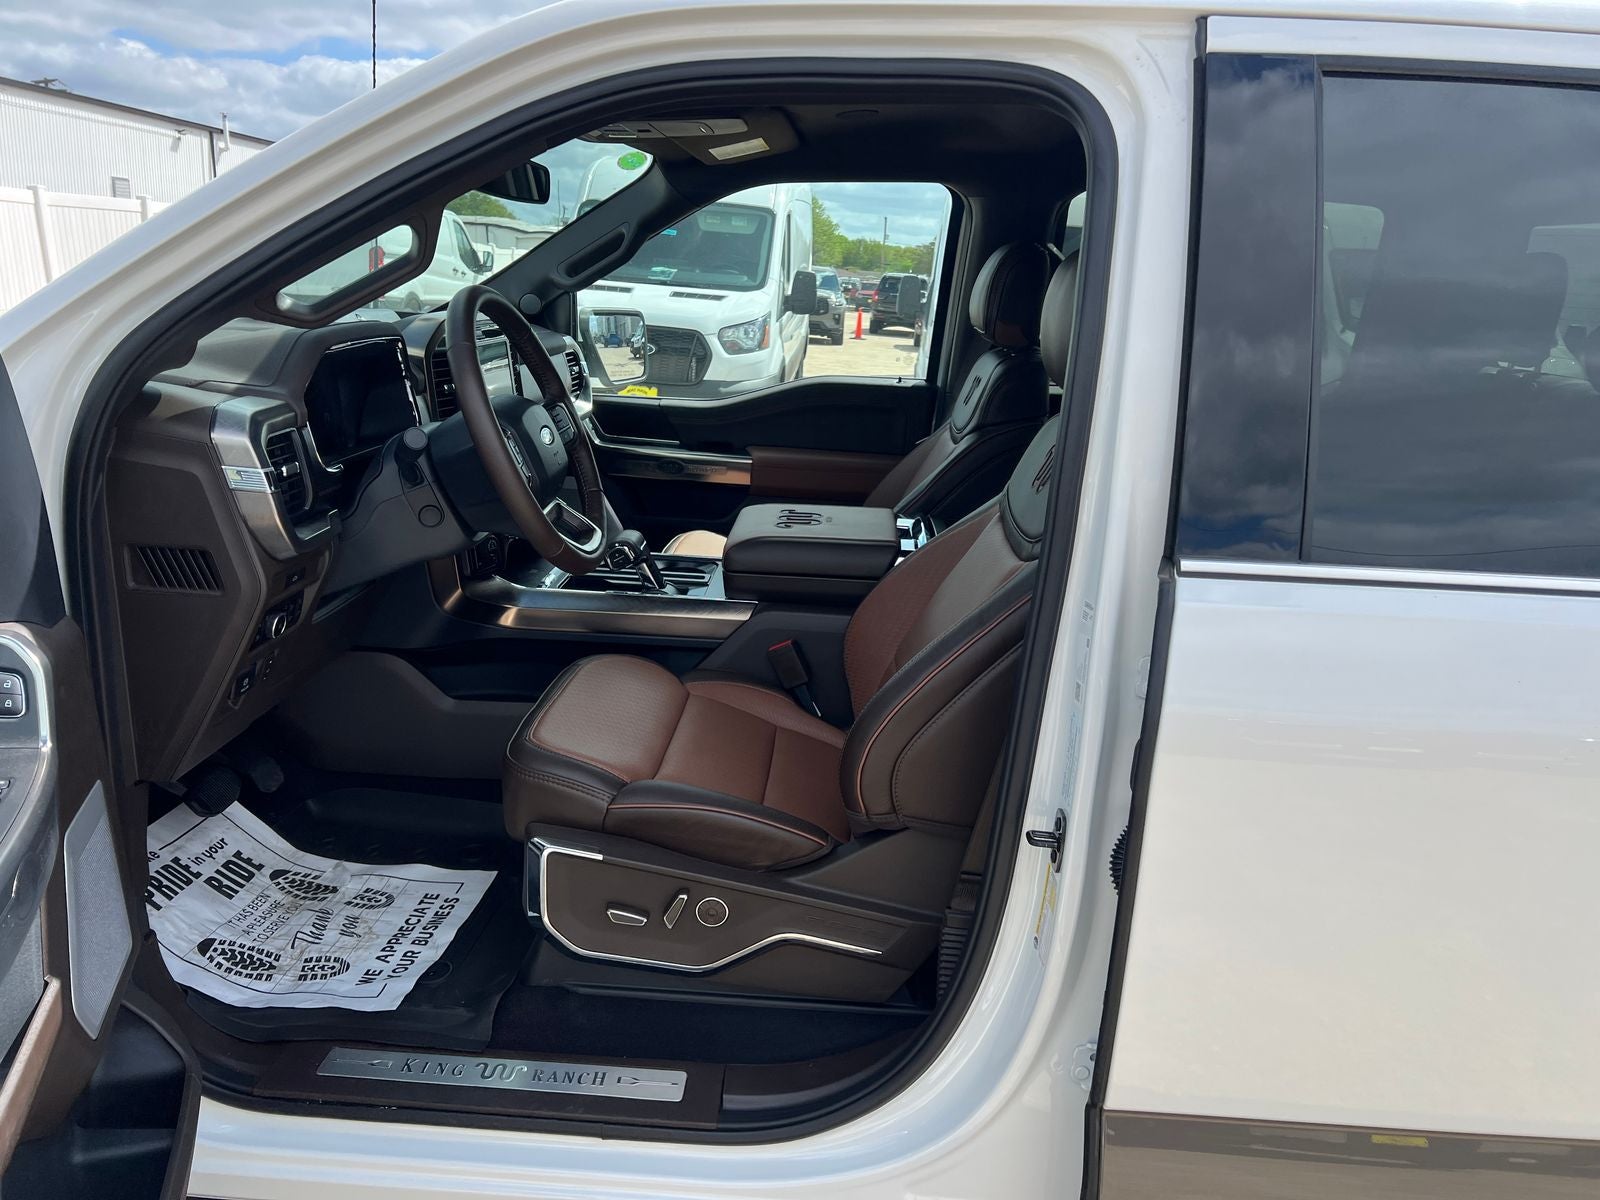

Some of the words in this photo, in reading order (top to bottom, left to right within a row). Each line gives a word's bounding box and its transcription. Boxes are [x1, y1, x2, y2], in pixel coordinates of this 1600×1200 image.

[145, 856, 203, 911] PRIDE
[187, 857, 206, 866] in
[201, 837, 229, 860] your
[203, 850, 265, 900] RIDE
[227, 919, 239, 929] IT
[233, 908, 254, 924] HAS
[248, 892, 271, 911] BEEN
[246, 899, 285, 932] PLEASURE
[252, 932, 269, 943] TO
[263, 914, 290, 936] SERVE
[290, 907, 334, 949] Thank
[338, 915, 361, 938] you
[241, 928, 253, 936] A
[355, 968, 384, 986] WE
[375, 893, 440, 963] APPRECIATE
[383, 950, 422, 980] YOUR
[410, 897, 460, 946] BUSINESS
[400, 1058, 467, 1078] KING
[531, 1069, 608, 1087] RANCH
